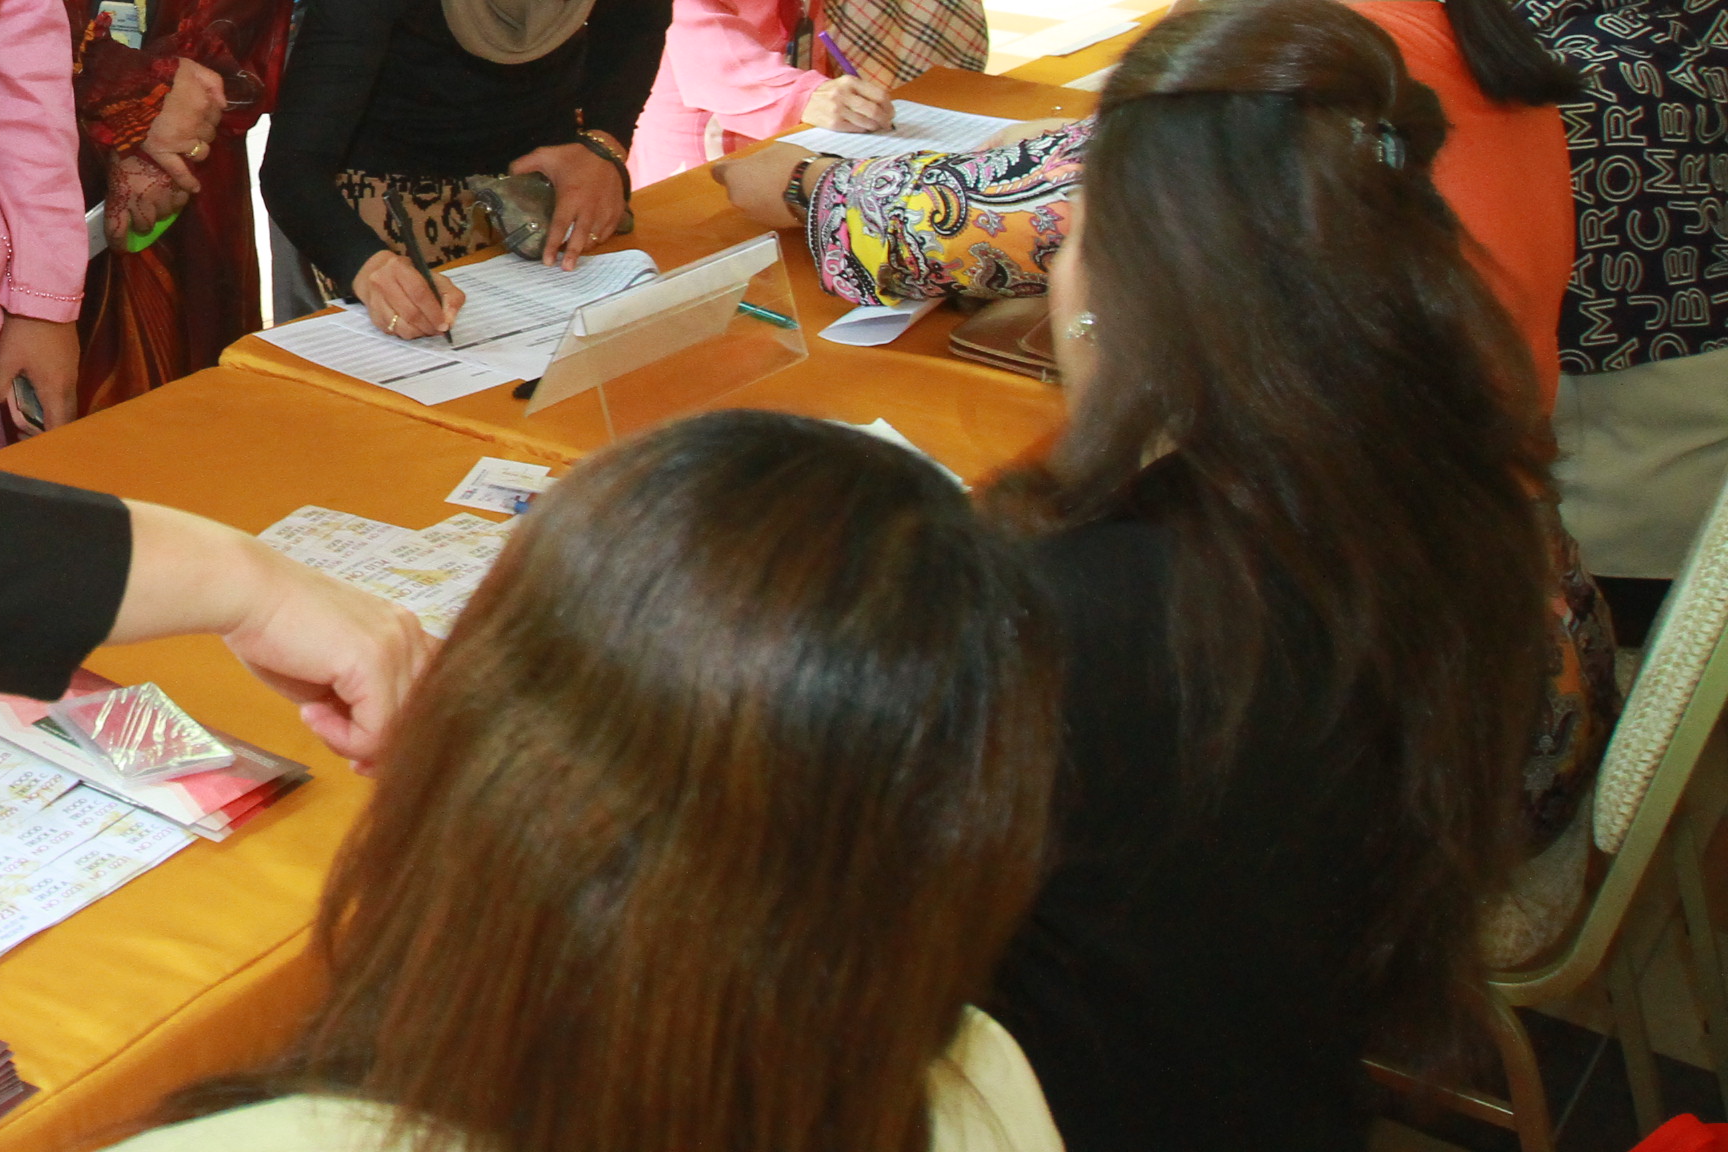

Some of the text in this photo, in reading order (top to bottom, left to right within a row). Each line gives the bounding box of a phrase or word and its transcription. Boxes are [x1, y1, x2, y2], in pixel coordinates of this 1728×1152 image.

[10, 772, 33, 787] FOOD
[62, 799, 86, 814] FOOD
[18, 826, 43, 841] FOOD
[120, 822, 144, 838] FOOD
[75, 850, 100, 866] FOOD
[27, 879, 53, 893] FOOD
